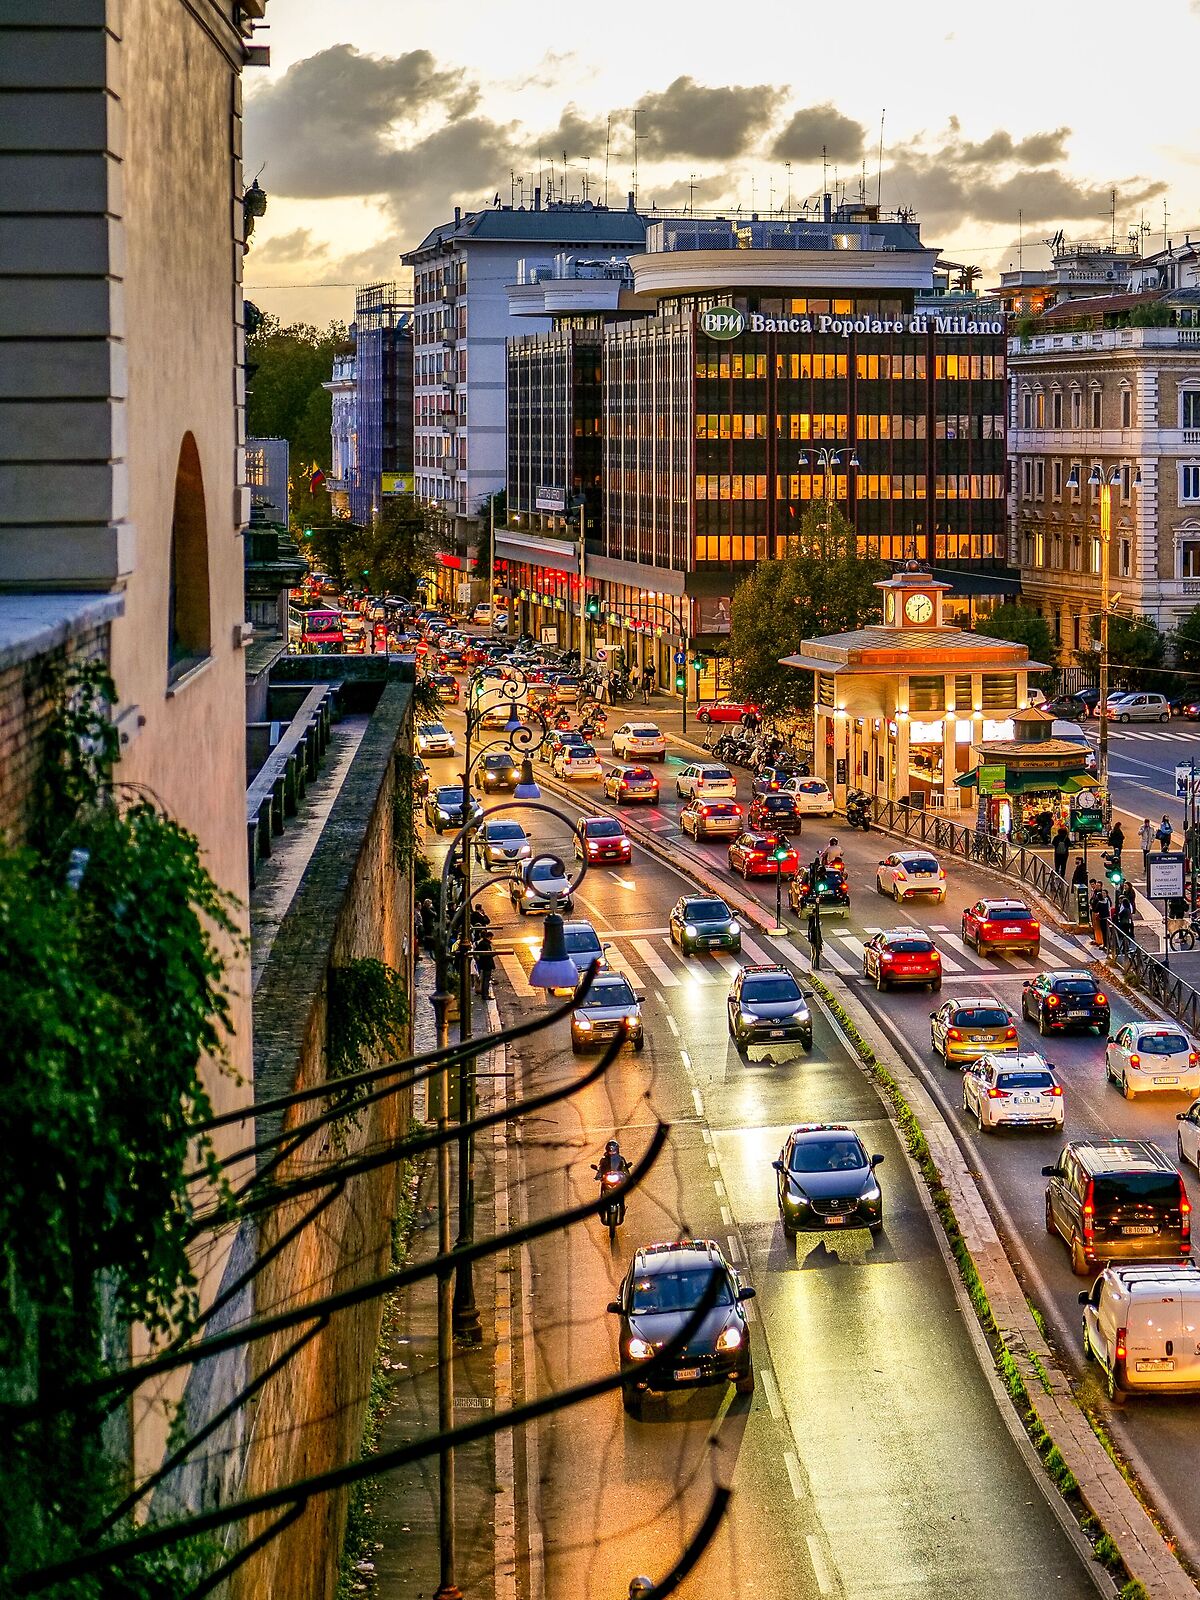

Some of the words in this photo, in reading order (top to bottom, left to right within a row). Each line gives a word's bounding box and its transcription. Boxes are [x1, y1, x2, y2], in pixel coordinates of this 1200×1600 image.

[704, 313, 743, 332] BPM
[750, 315, 812, 333] Banca
[818, 315, 903, 338] Popolare
[908, 316, 928, 334] di
[934, 316, 1003, 335] Milano
